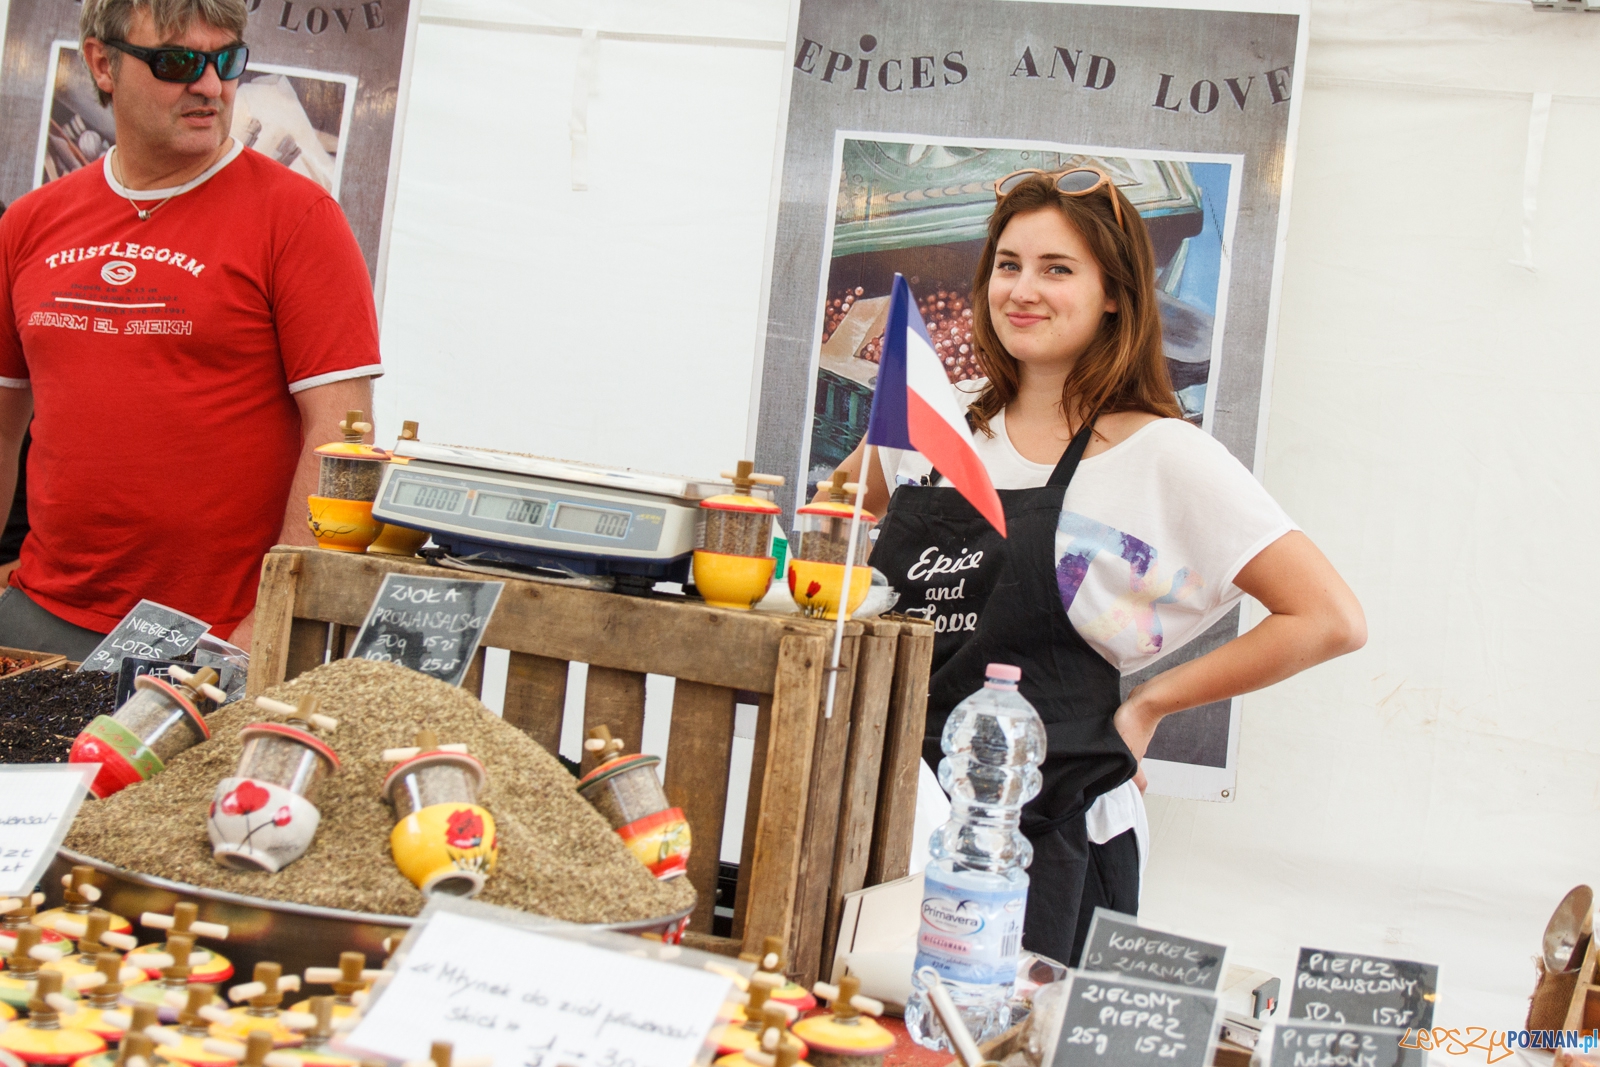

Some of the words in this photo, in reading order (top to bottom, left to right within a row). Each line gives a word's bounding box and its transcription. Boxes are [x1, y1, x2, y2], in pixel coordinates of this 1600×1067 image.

[277, 0, 386, 35] LOVE
[1010, 46, 1117, 91] AND
[1151, 65, 1292, 114] LOVE
[45, 241, 206, 278] THISTLEGORM
[28, 312, 89, 331] SHARM
[93, 317, 119, 334] EL
[124, 320, 193, 336] SHEIKH
[907, 546, 984, 581] Epice
[925, 578, 965, 601] and
[923, 904, 979, 927] Primavera
[1108, 931, 1200, 963] KOPEREK
[1113, 955, 1212, 986] ZIARNACH
[1309, 953, 1395, 978] PIEPRZ
[1297, 972, 1418, 996] POKRUSZONY
[1081, 984, 1182, 1016] ZIELONY
[1100, 1006, 1185, 1039] PIEPRZ
[1282, 1029, 1379, 1051] PIEPRZ
